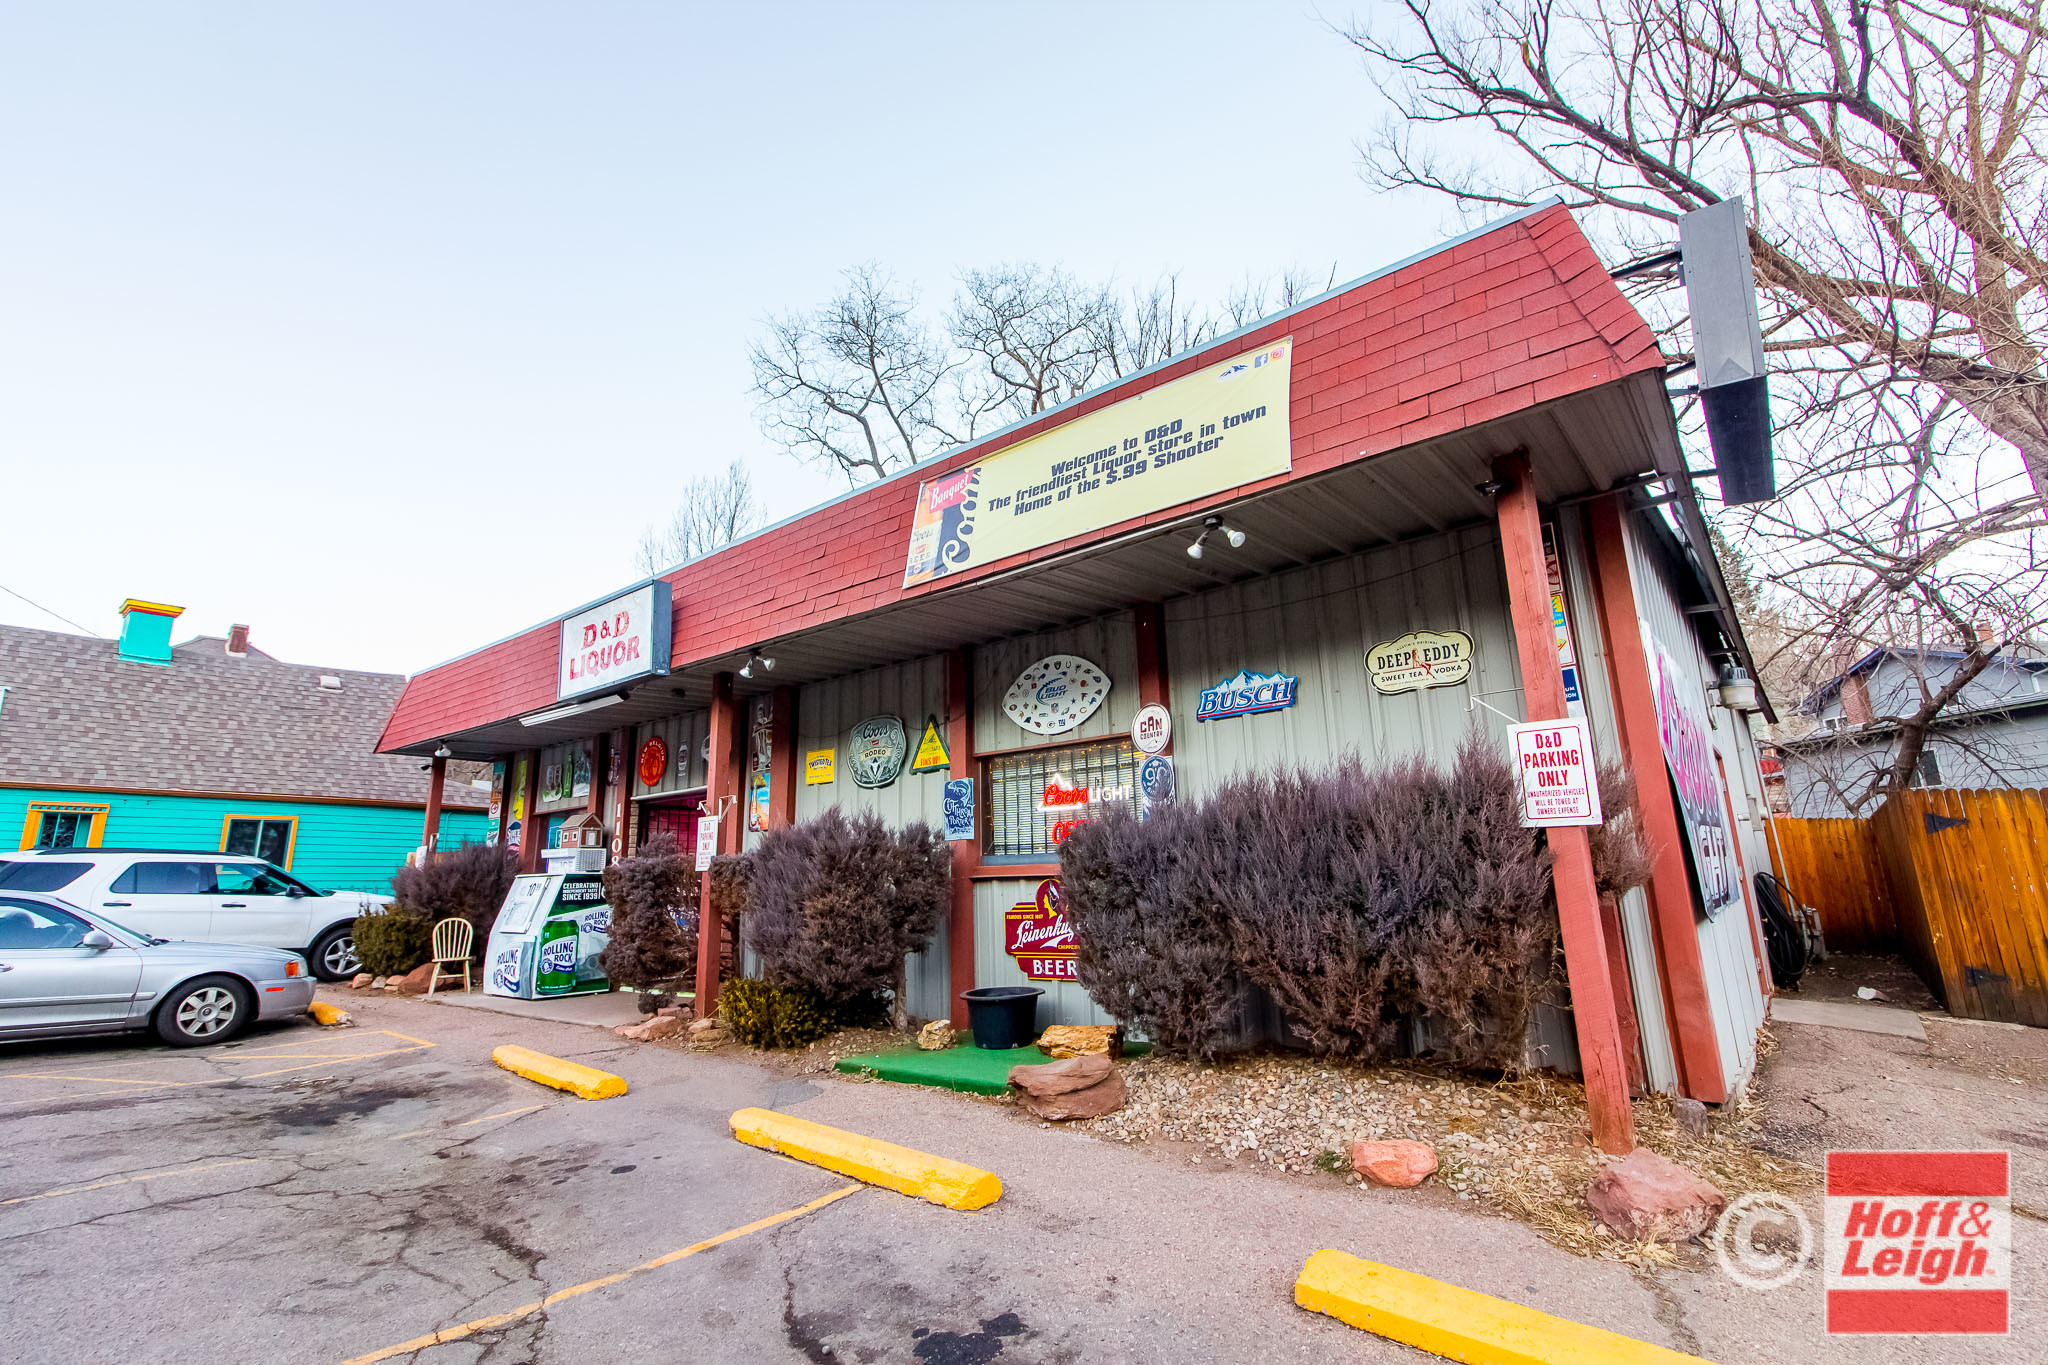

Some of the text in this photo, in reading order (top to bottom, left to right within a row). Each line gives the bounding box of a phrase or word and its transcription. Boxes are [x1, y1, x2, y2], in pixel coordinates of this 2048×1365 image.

[1051, 418, 1183, 476] Welcome to D&D
[988, 405, 1266, 511] The friendliest Liquor store in town
[1014, 436, 1224, 516] Home of the $.99 Shooter
[930, 474, 969, 511] Banquet
[569, 635, 641, 680] LIQUOR
[1377, 643, 1460, 670] DEEP EDDY
[1381, 673, 1406, 683] SWEET
[1434, 664, 1462, 674] VODKA
[1040, 690, 1068, 700] LIGHT
[1044, 684, 1067, 694] BUD
[1200, 678, 1295, 714] BUSCH
[863, 722, 889, 739] Coors
[1140, 716, 1163, 733] CAN
[1140, 730, 1163, 740] COUNTRY
[1535, 732, 1562, 749] D&D
[649, 740, 665, 762] BELGIUM
[864, 749, 887, 758] RODEO
[1523, 749, 1580, 769] PARKING
[1537, 769, 1568, 788] ONLY
[1043, 783, 1132, 806] Coors LIGHT
[1526, 788, 1585, 798] UNAUTHORIZED VEHICLES
[583, 892, 598, 900] 1939
[584, 911, 609, 923] ROLLING
[543, 941, 574, 956] ROLLING
[497, 949, 518, 966] ROLLING
[553, 953, 573, 963] ROCK
[504, 964, 517, 977] ROCK
[1032, 959, 1078, 976] BEER
